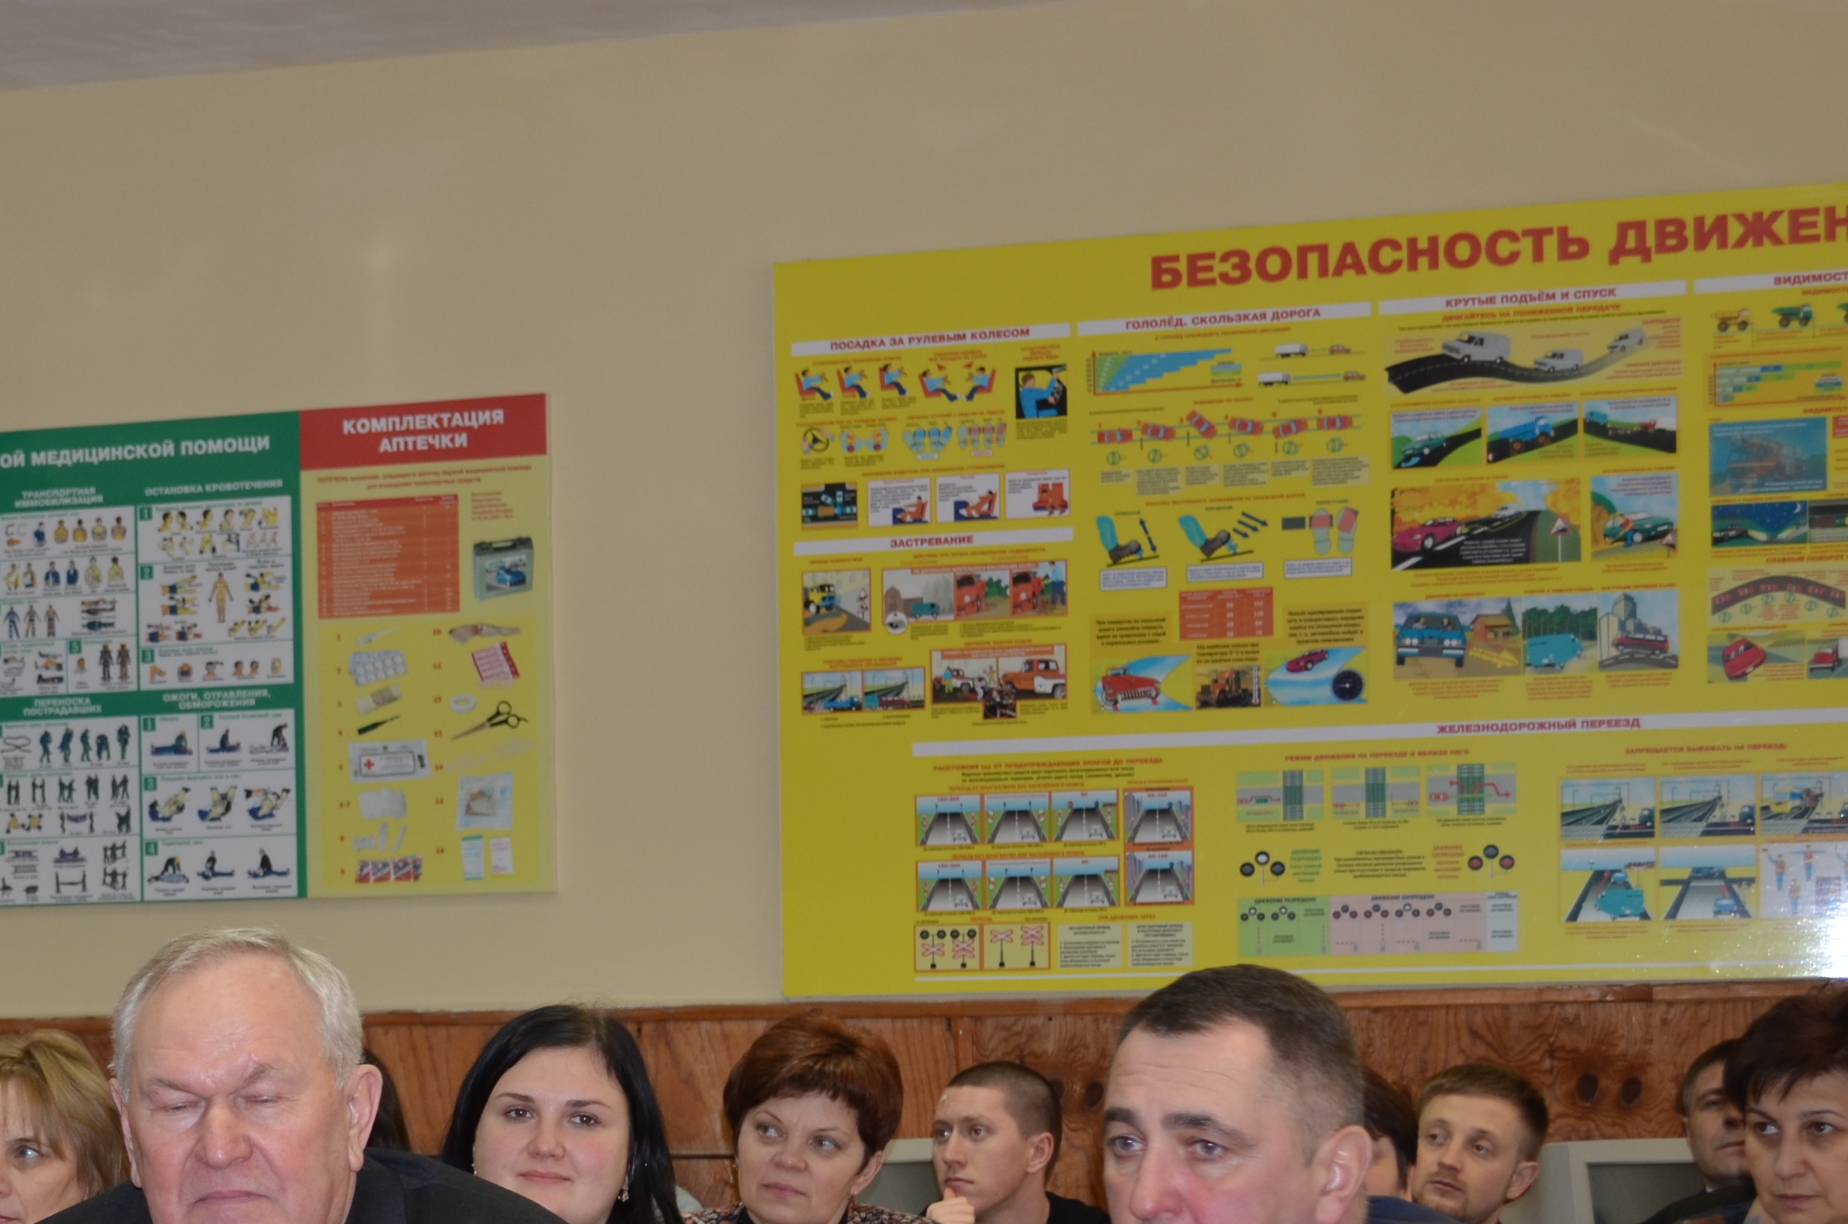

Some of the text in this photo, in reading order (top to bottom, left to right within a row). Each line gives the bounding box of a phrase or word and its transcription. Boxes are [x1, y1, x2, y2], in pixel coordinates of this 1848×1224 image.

[1150, 225, 1591, 290] БЕЗОПАСНОСТЬ
[1445, 288, 1616, 308] КРУТЫЕ ПОДЪЁМ И СПУСК
[1126, 309, 1321, 331] ГОЛОЛЁД. СКОЛЬЗКАЯ ДОРОГА
[1442, 304, 1620, 322] ДВИГАЙТЕСЬ НА ПОНИЖЕННОЙ ПЕРЕДАЧЕ
[830, 328, 1030, 352] ПОСАДКА ЗА РУЛЕВЫМ КОЛЕСОМ
[343, 409, 504, 434] КОМПЛЕКТАЦИЯ
[31, 440, 175, 467] МЕДИЦИНСКОЙ
[181, 436, 270, 456] ПОМОЩИ
[380, 433, 468, 453] АПТЕЧКИ
[22, 487, 96, 499] ТРАНСПОРТНАЯ
[145, 479, 283, 497] ОСТАНОВКА КРОВОТЕЧЕНИЯ
[15, 495, 103, 508] ИММОБИЛИЗАЦИЯ
[891, 535, 974, 548] ЗАСТРЕВАНИЕ
[34, 697, 91, 707] ПЕРЕНОСКА
[163, 690, 271, 702] ОЖОГИ, ОТРАВЛЕНИЯ,
[179, 699, 256, 710] ОБМОРОЖЕНИЯ
[23, 705, 102, 717] ПОСТРАДАВШИХ
[1437, 718, 1641, 734] ЖЕЛЕЗНОДОРОЖНЫЙ ПЕРЕЕЗД
